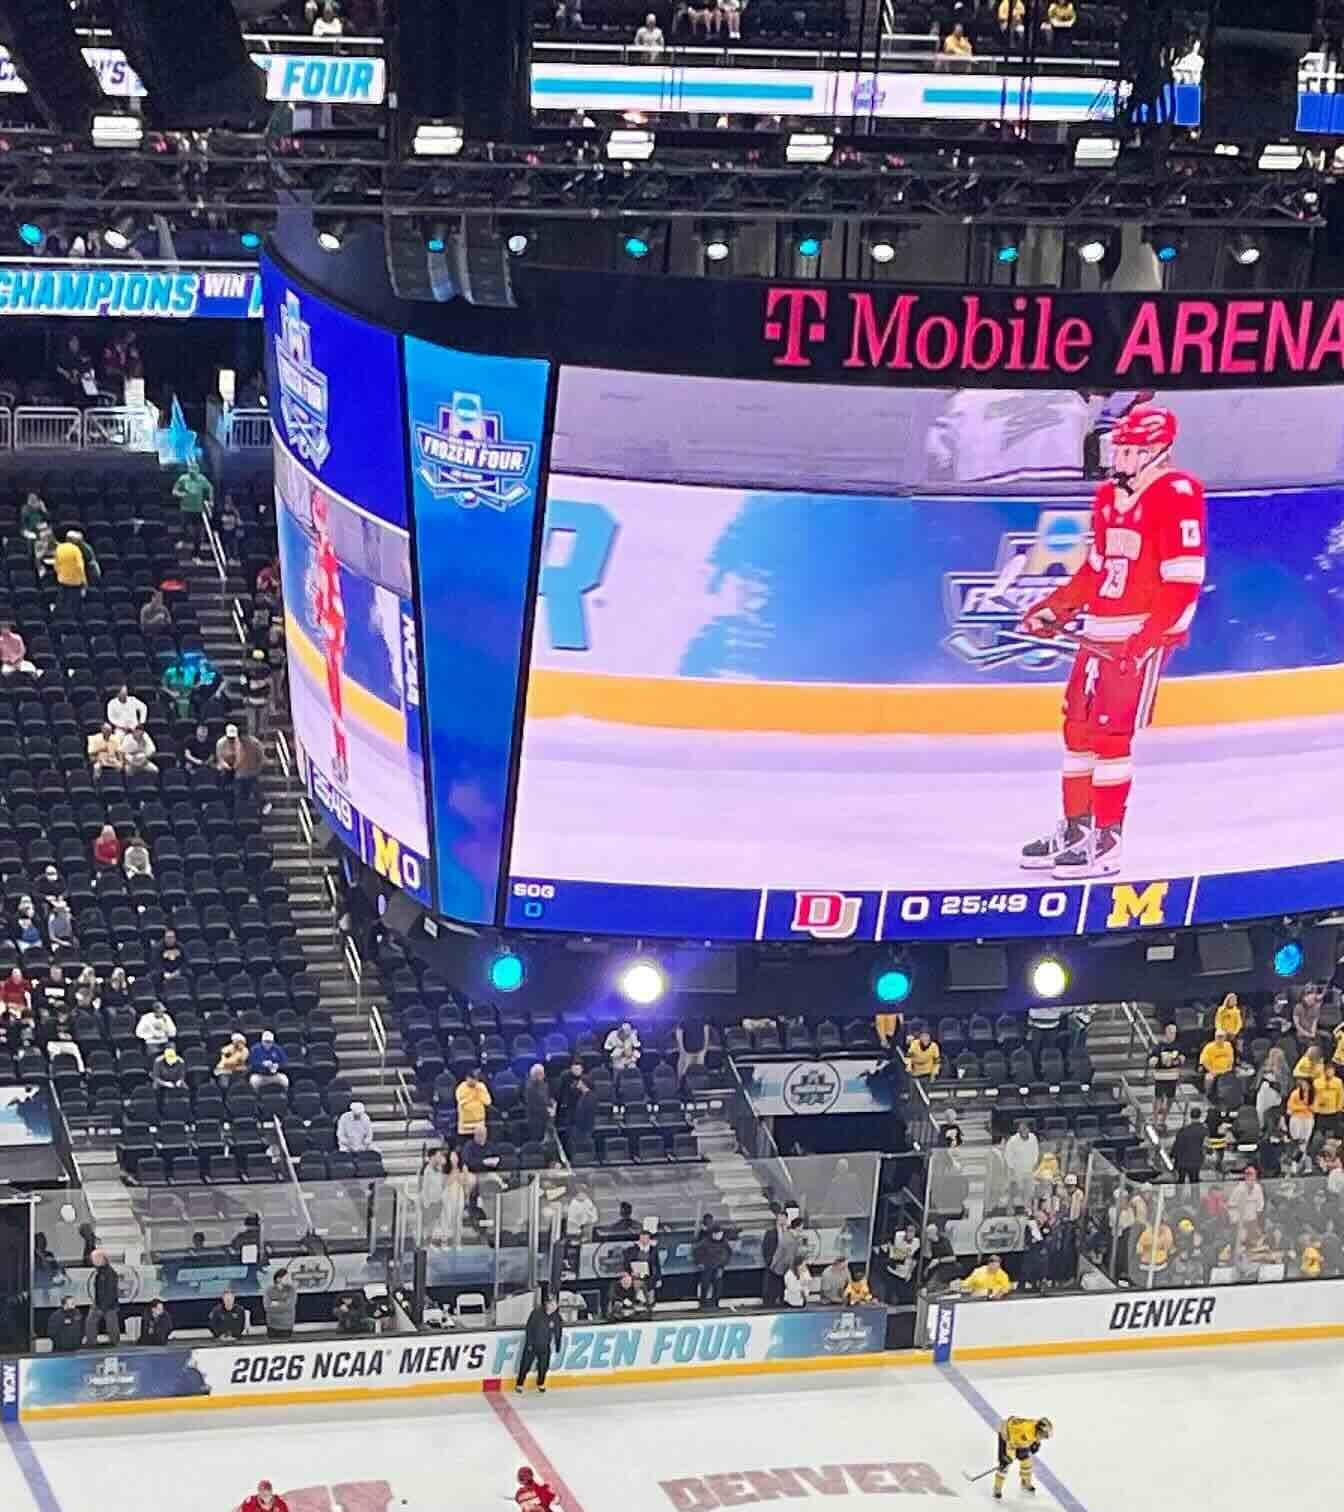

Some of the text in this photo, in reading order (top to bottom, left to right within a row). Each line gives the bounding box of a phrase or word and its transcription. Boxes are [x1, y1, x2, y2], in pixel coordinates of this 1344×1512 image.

[280, 60, 375, 98] FOUR
[203, 274, 245, 297] WIN
[843, 293, 1093, 371] Mobile
[479, 447, 525, 471] FOUR
[941, 893, 1028, 916] 25:49
[1105, 883, 1170, 928] M
[1109, 1297, 1216, 1331] DENVER
[230, 1355, 304, 1385] 2026
[398, 1343, 486, 1375] MEN'S
[491, 1327, 641, 1377] FOZEN
[650, 1323, 753, 1364] FOUR
